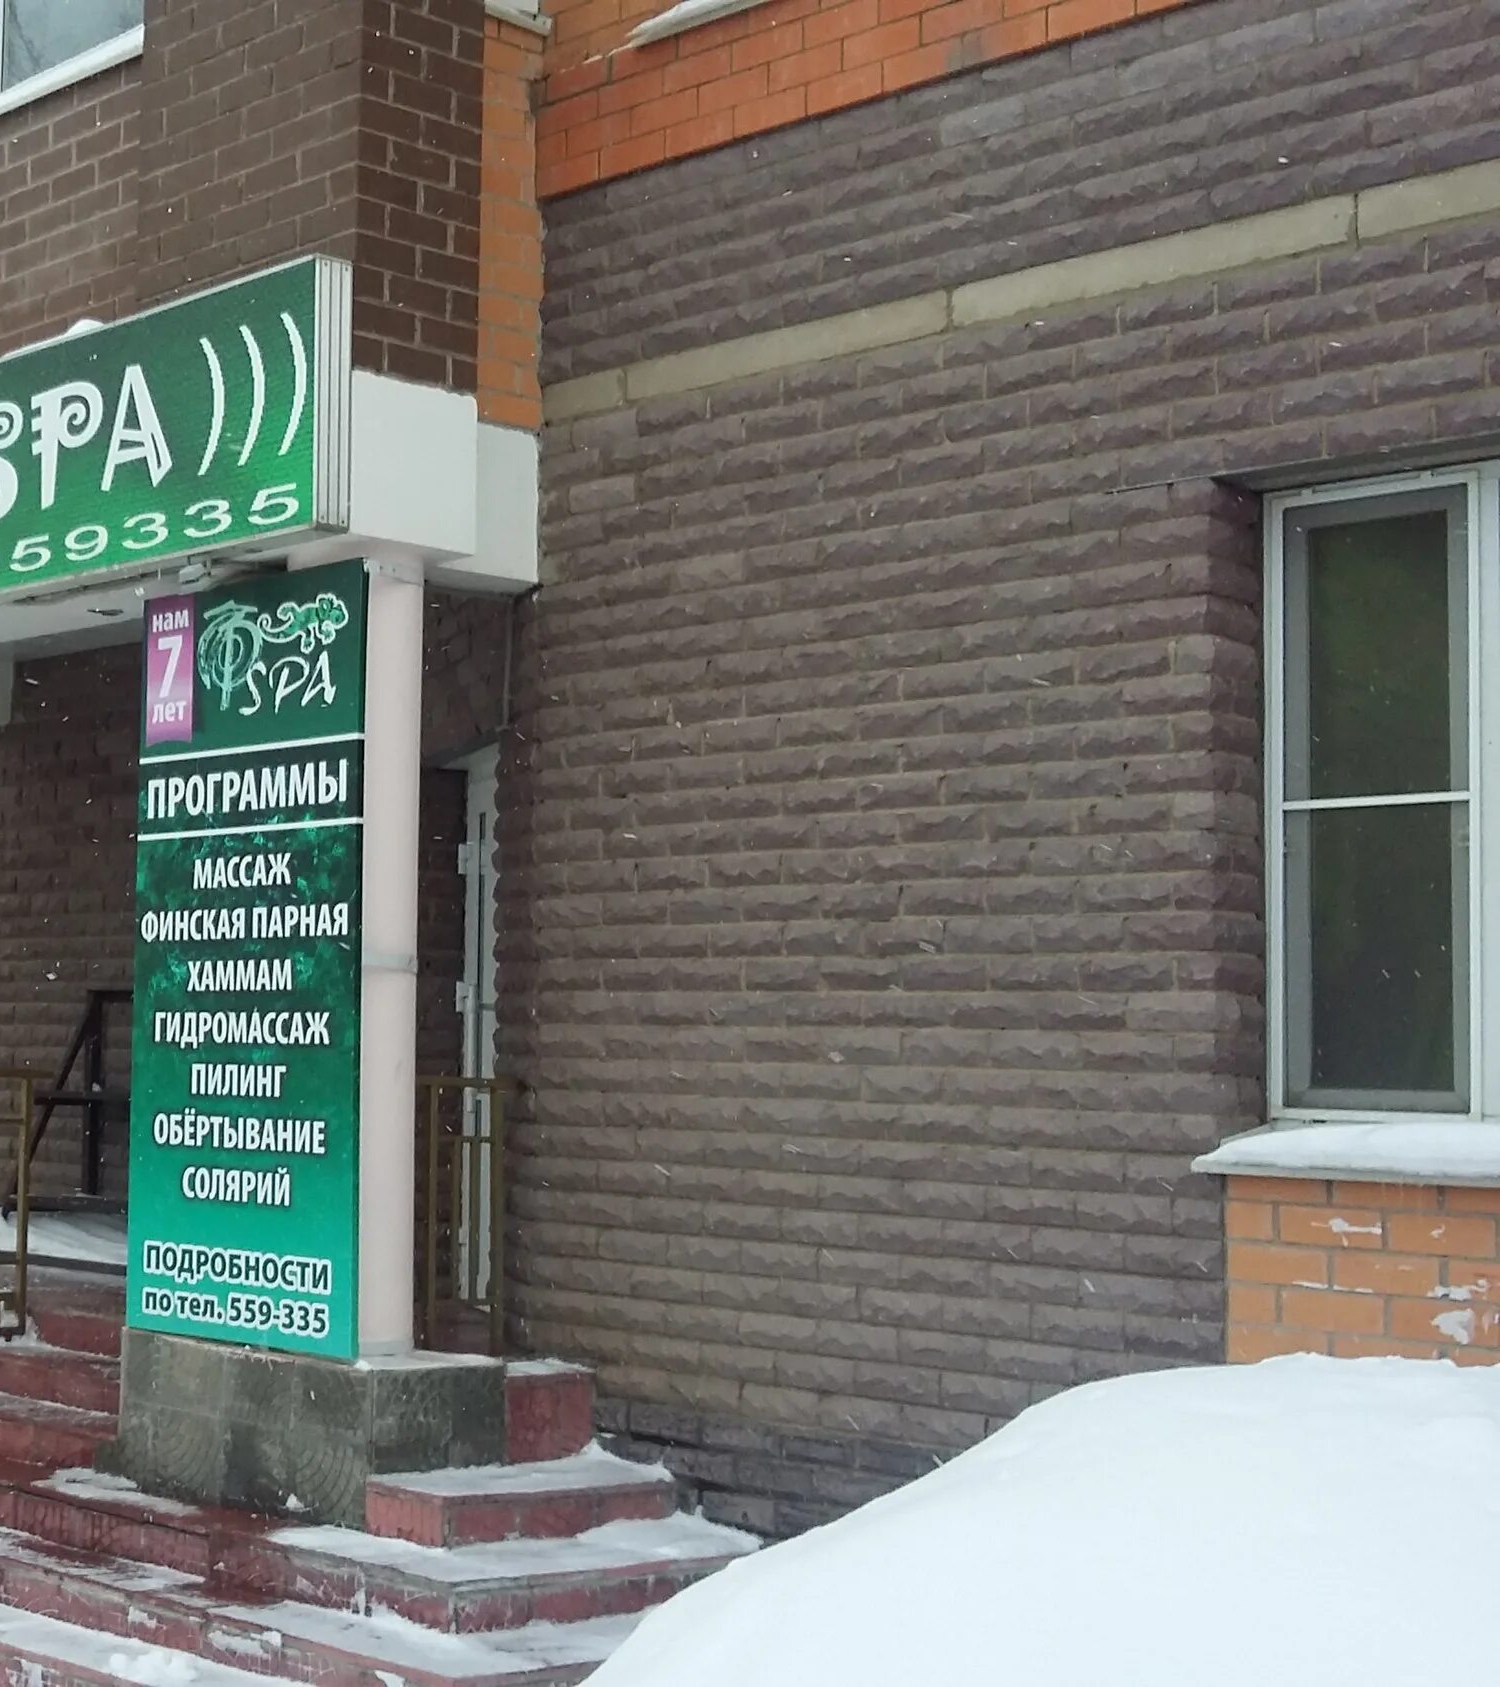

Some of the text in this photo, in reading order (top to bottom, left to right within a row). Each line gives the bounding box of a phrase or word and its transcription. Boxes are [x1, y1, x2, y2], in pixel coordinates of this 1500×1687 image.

[152, 608, 190, 633] нам
[158, 634, 184, 699] 7
[239, 650, 337, 716] SPA
[151, 700, 187, 724] лет
[147, 758, 348, 820] ПРОГРАММЫ
[193, 851, 292, 890] МАССАЖ
[141, 902, 350, 942] ФИНСКАЯ ПАРНАЯ
[187, 958, 292, 993] ХАММАМ
[153, 1010, 331, 1048] ГИДРОМАССАЖ
[191, 1063, 287, 1098] ПИЛИНГ
[153, 1108, 326, 1155] ОБЁРТЫВАНИЕ
[182, 1165, 291, 1207] СОЛЯРИЙ
[145, 1243, 330, 1292] ПОДРОБНОСТИ
[145, 1290, 328, 1335] по тел. 559-335
